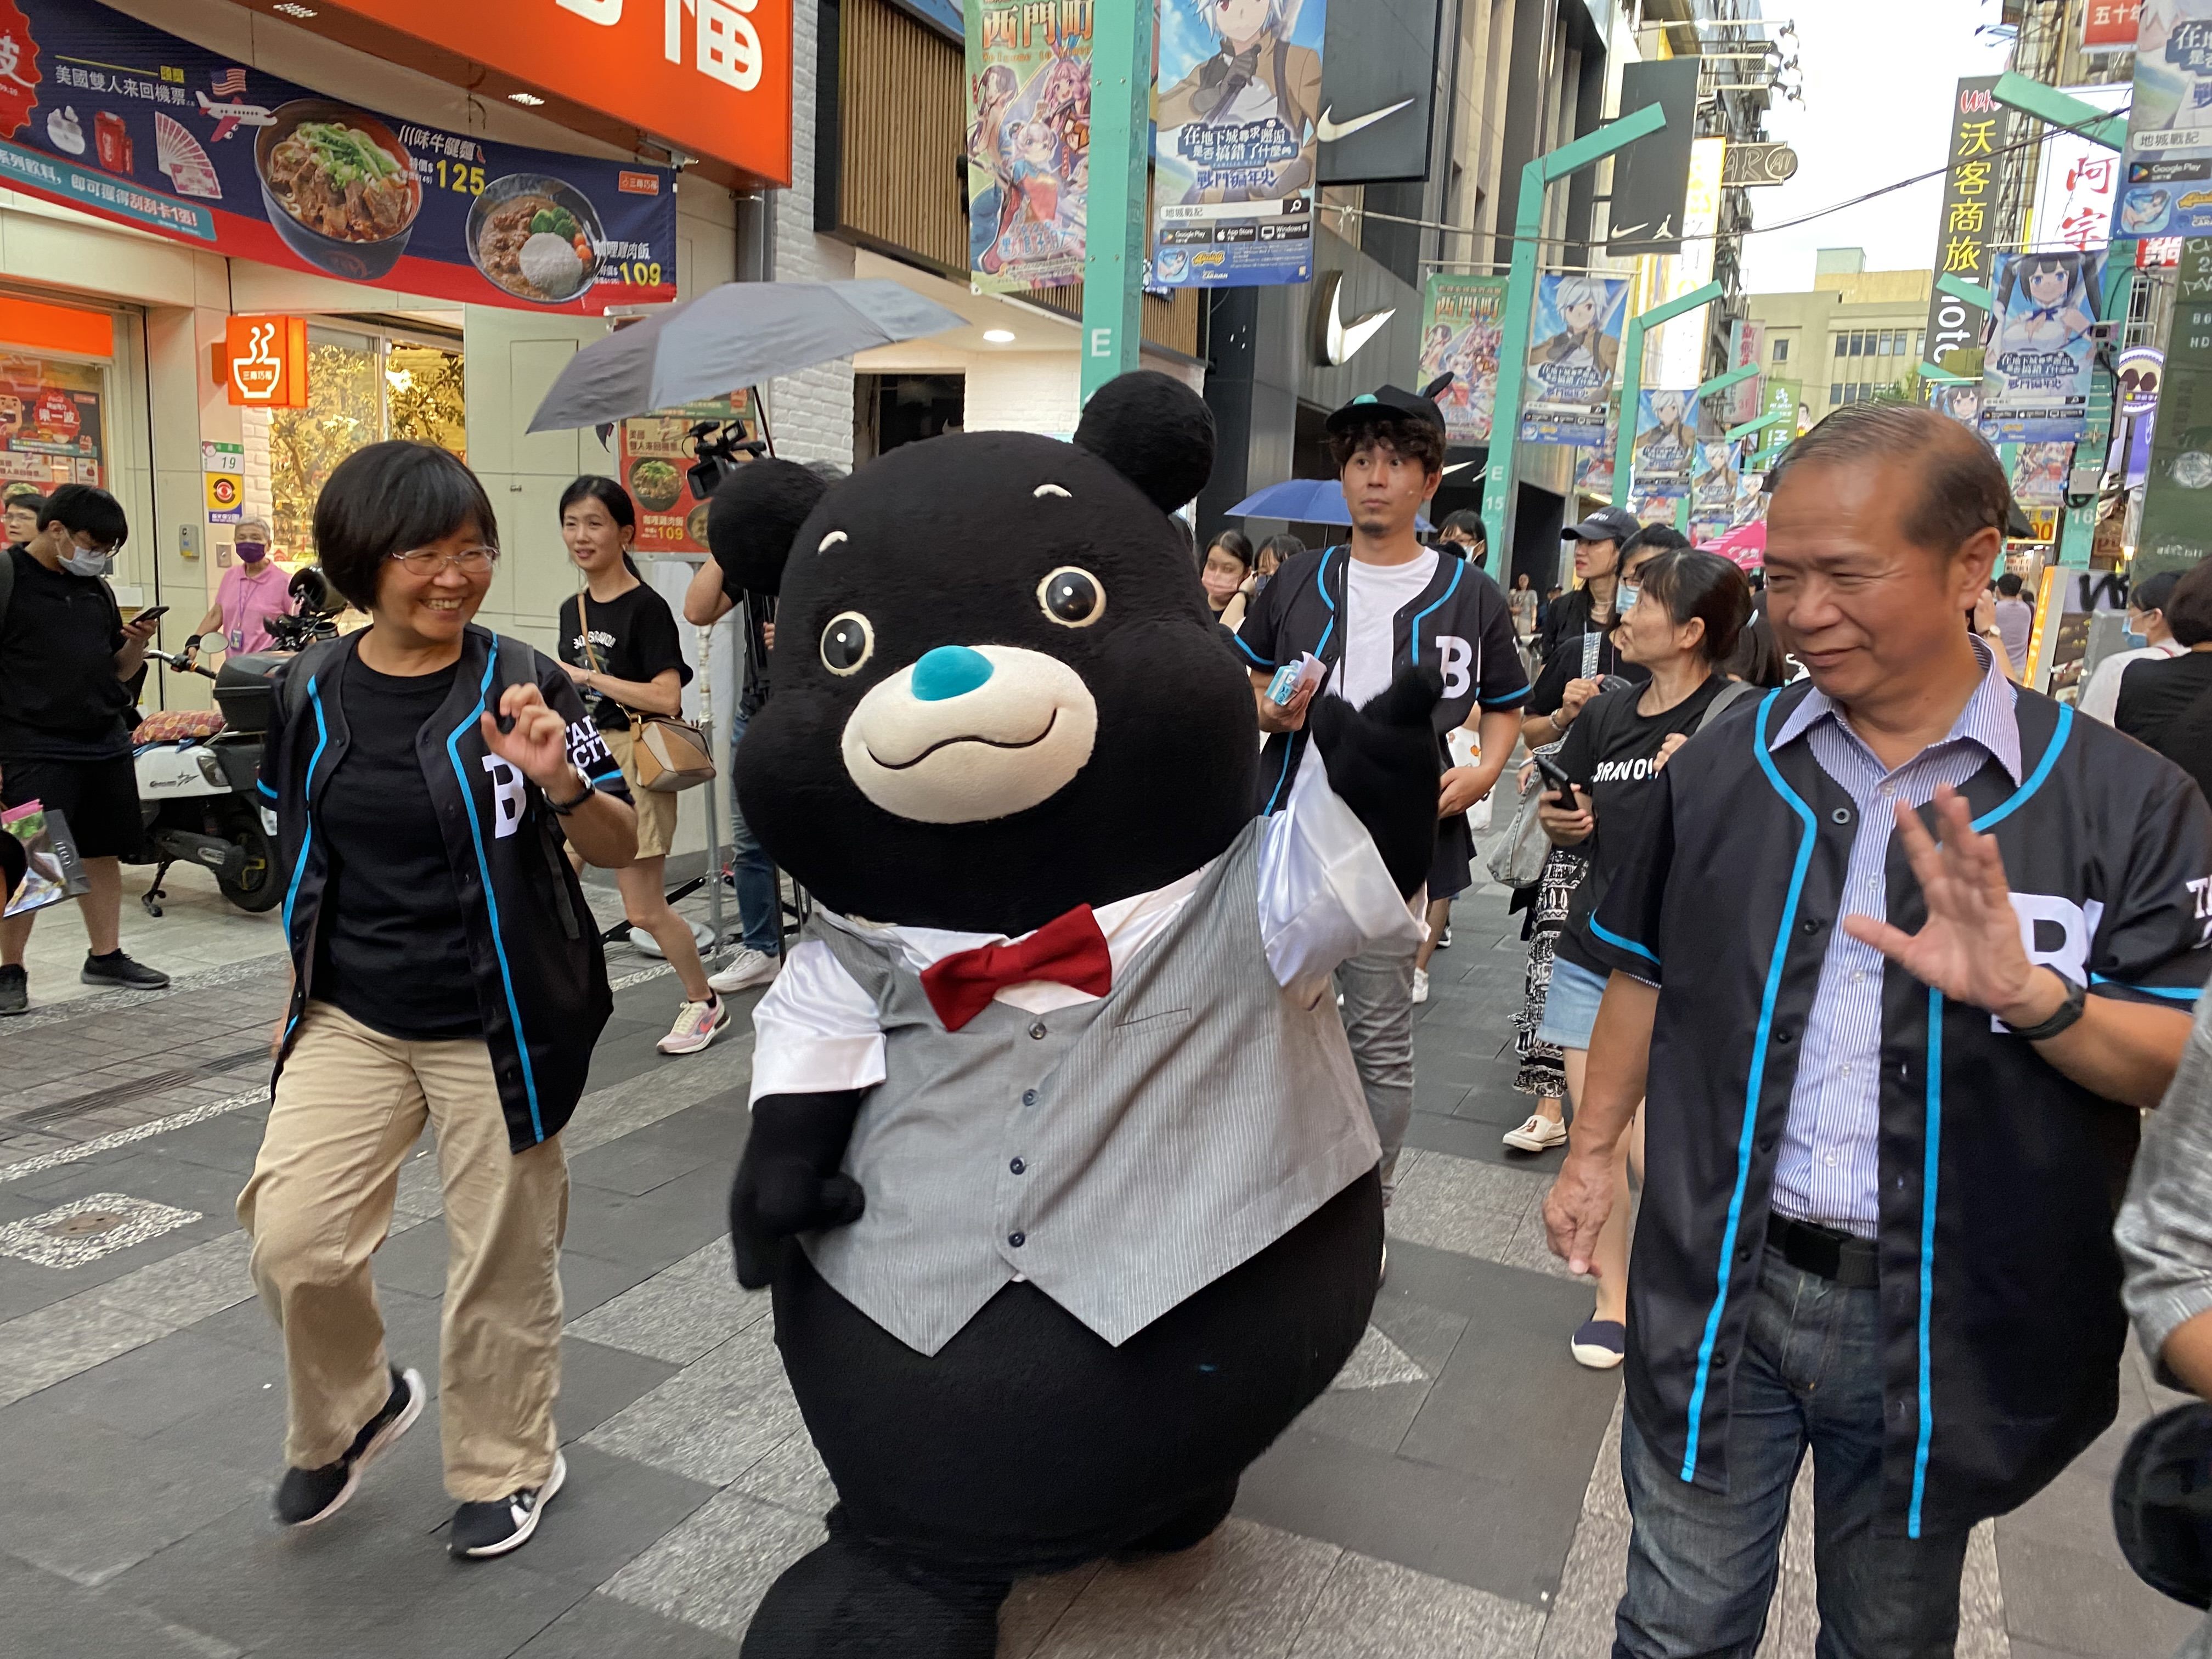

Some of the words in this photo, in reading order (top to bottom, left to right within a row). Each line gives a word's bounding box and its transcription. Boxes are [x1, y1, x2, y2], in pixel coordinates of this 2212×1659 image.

[2141, 131, 2199, 146] 地城戰記
[2152, 164, 2183, 174] Google
[2183, 162, 2202, 172] Play
[436, 159, 485, 196] 125
[1942, 119, 1996, 272] 沃客商旅
[2061, 155, 2120, 251] 阿宗
[1194, 230, 1206, 239] Play
[1227, 229, 1238, 238] App
[1239, 228, 1254, 236] Store
[1276, 224, 1302, 234] Windows
[619, 262, 662, 287] 109
[1091, 329, 1111, 357] E
[242, 371, 273, 381] 三商巧福
[221, 456, 236, 470] 19
[1492, 466, 1504, 480] E
[1486, 495, 1503, 511] 15
[2071, 508, 2094, 525] 16
[658, 526, 684, 540] 109
[1436, 635, 1472, 699] B
[1593, 758, 1654, 783] BRAVO!
[482, 752, 527, 839] B
